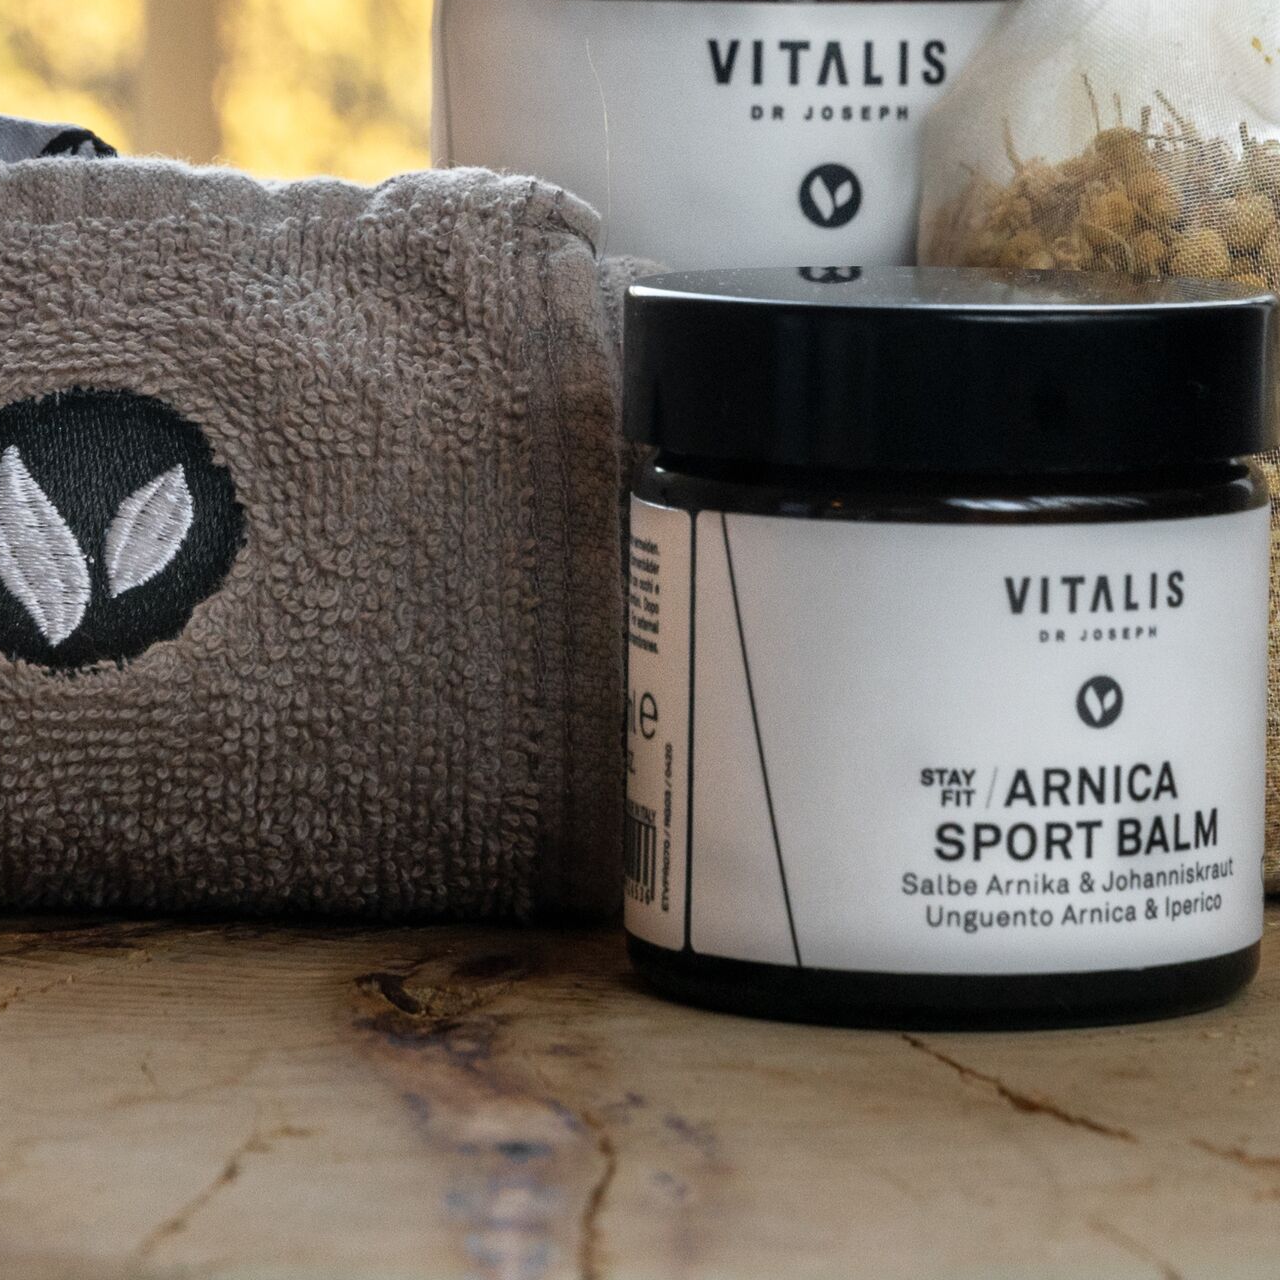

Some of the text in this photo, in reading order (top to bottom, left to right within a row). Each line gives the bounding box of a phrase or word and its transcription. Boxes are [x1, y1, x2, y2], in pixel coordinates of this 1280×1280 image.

[707, 38, 946, 86] VITALIS
[751, 105, 909, 121] DR JOSEPH
[1004, 570, 1184, 615] VITALIS
[1039, 626, 1156, 643] DR JOSEPH
[921, 768, 975, 786] STAY
[1004, 761, 1178, 807] ARNICA
[941, 789, 975, 807] FIT
[934, 808, 1217, 862] SPORT BALM
[902, 857, 1233, 896] Salbe Arnika & Johanniskraut
[926, 894, 1222, 934] Unguento Arnica & Iperico
